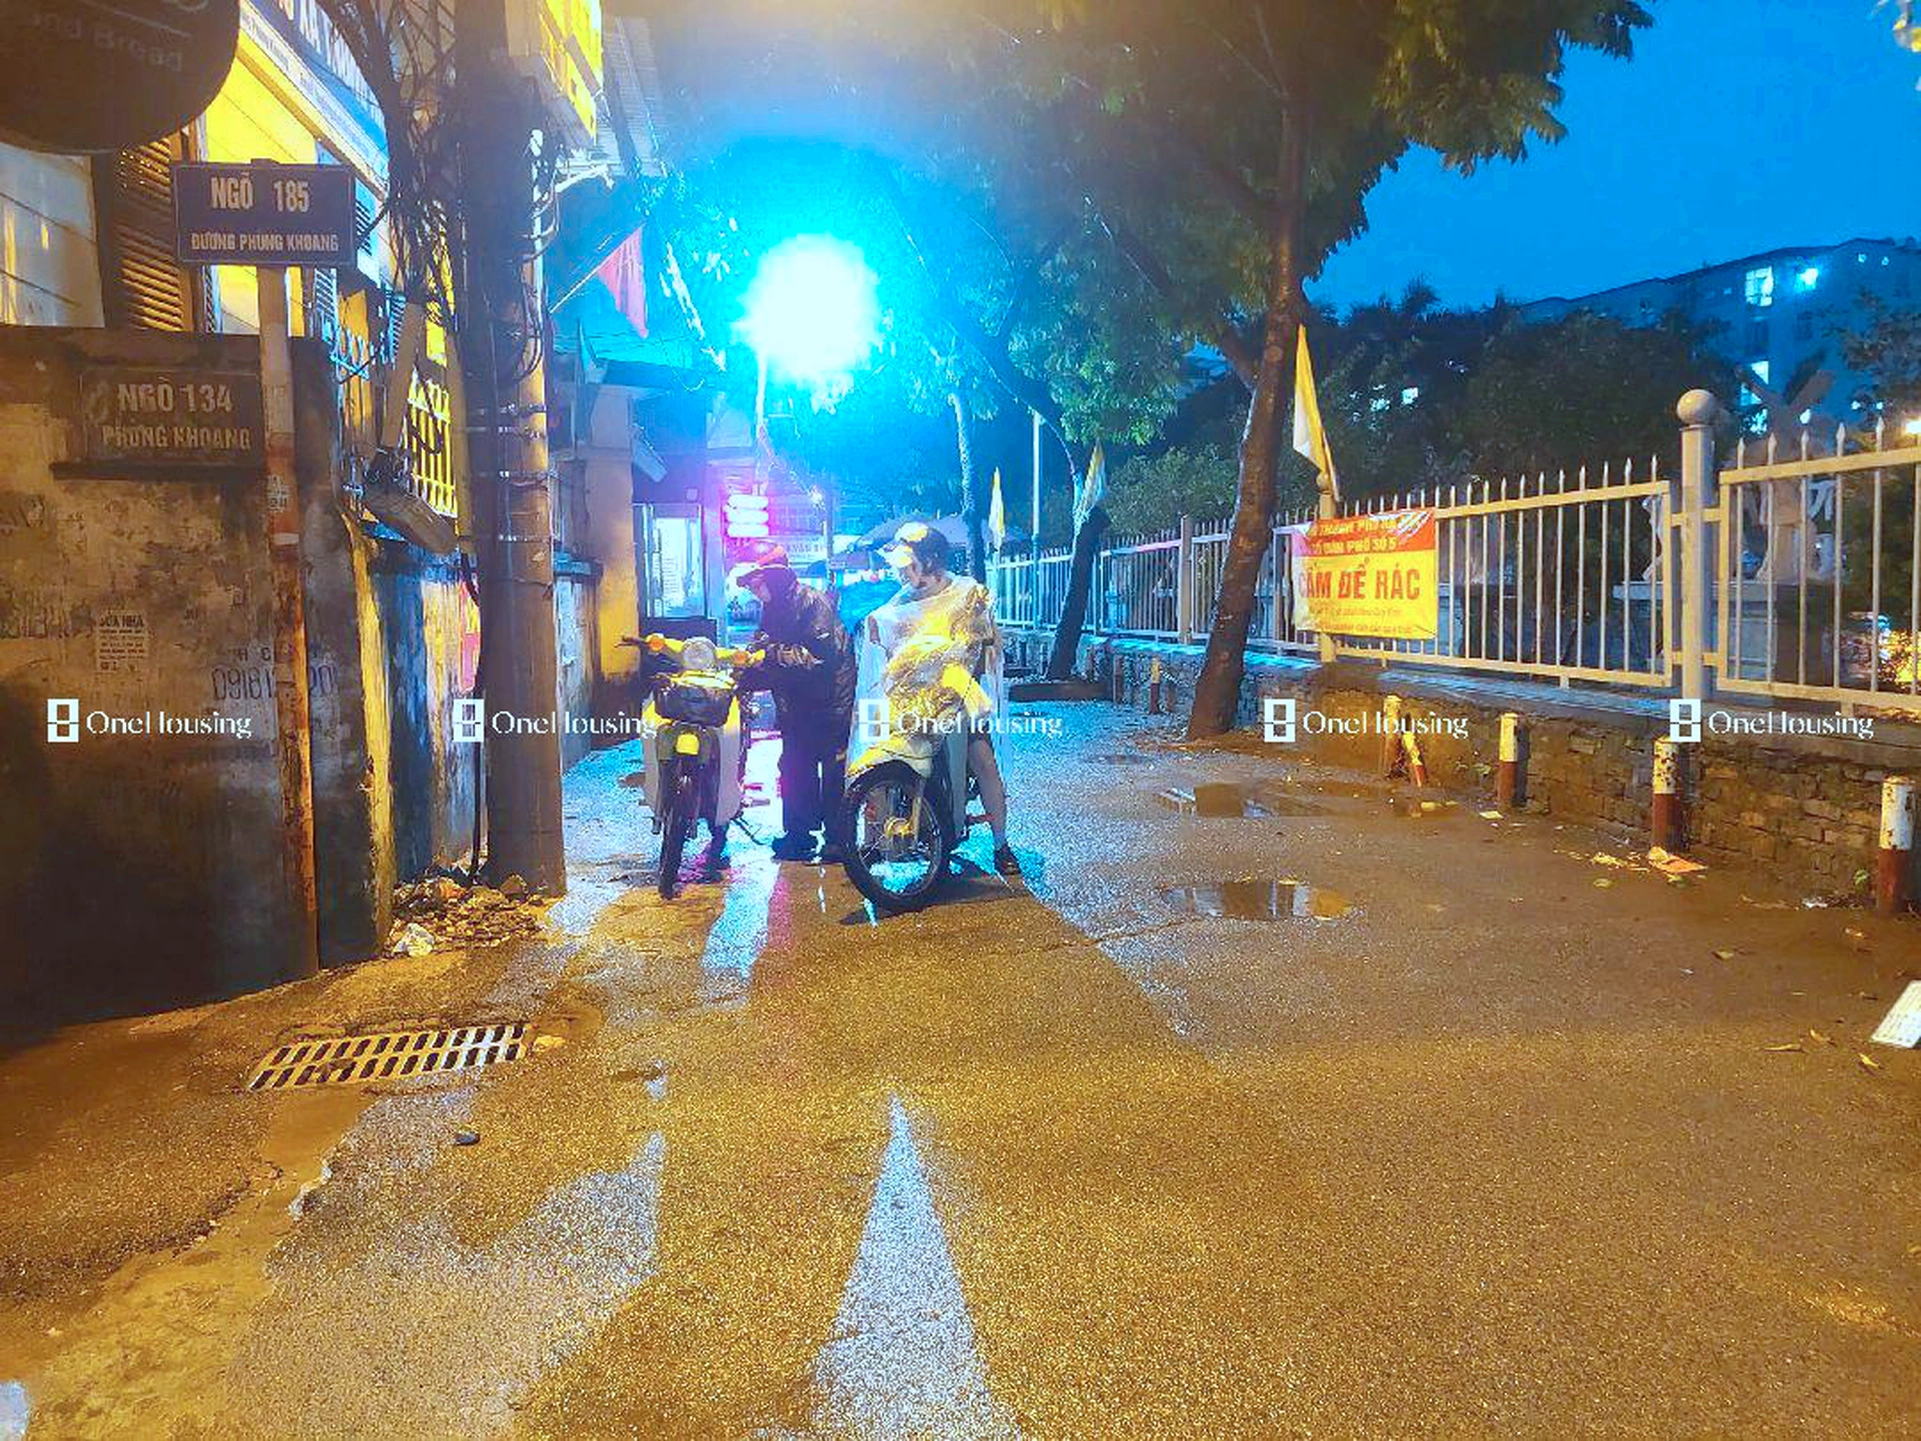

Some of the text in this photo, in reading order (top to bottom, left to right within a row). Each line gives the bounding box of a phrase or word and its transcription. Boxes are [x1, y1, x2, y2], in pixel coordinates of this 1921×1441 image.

[273, 179, 310, 213] 185
[286, 233, 339, 251] KHOANG
[179, 383, 233, 413] 134
[1375, 562, 1421, 600] RÁC
